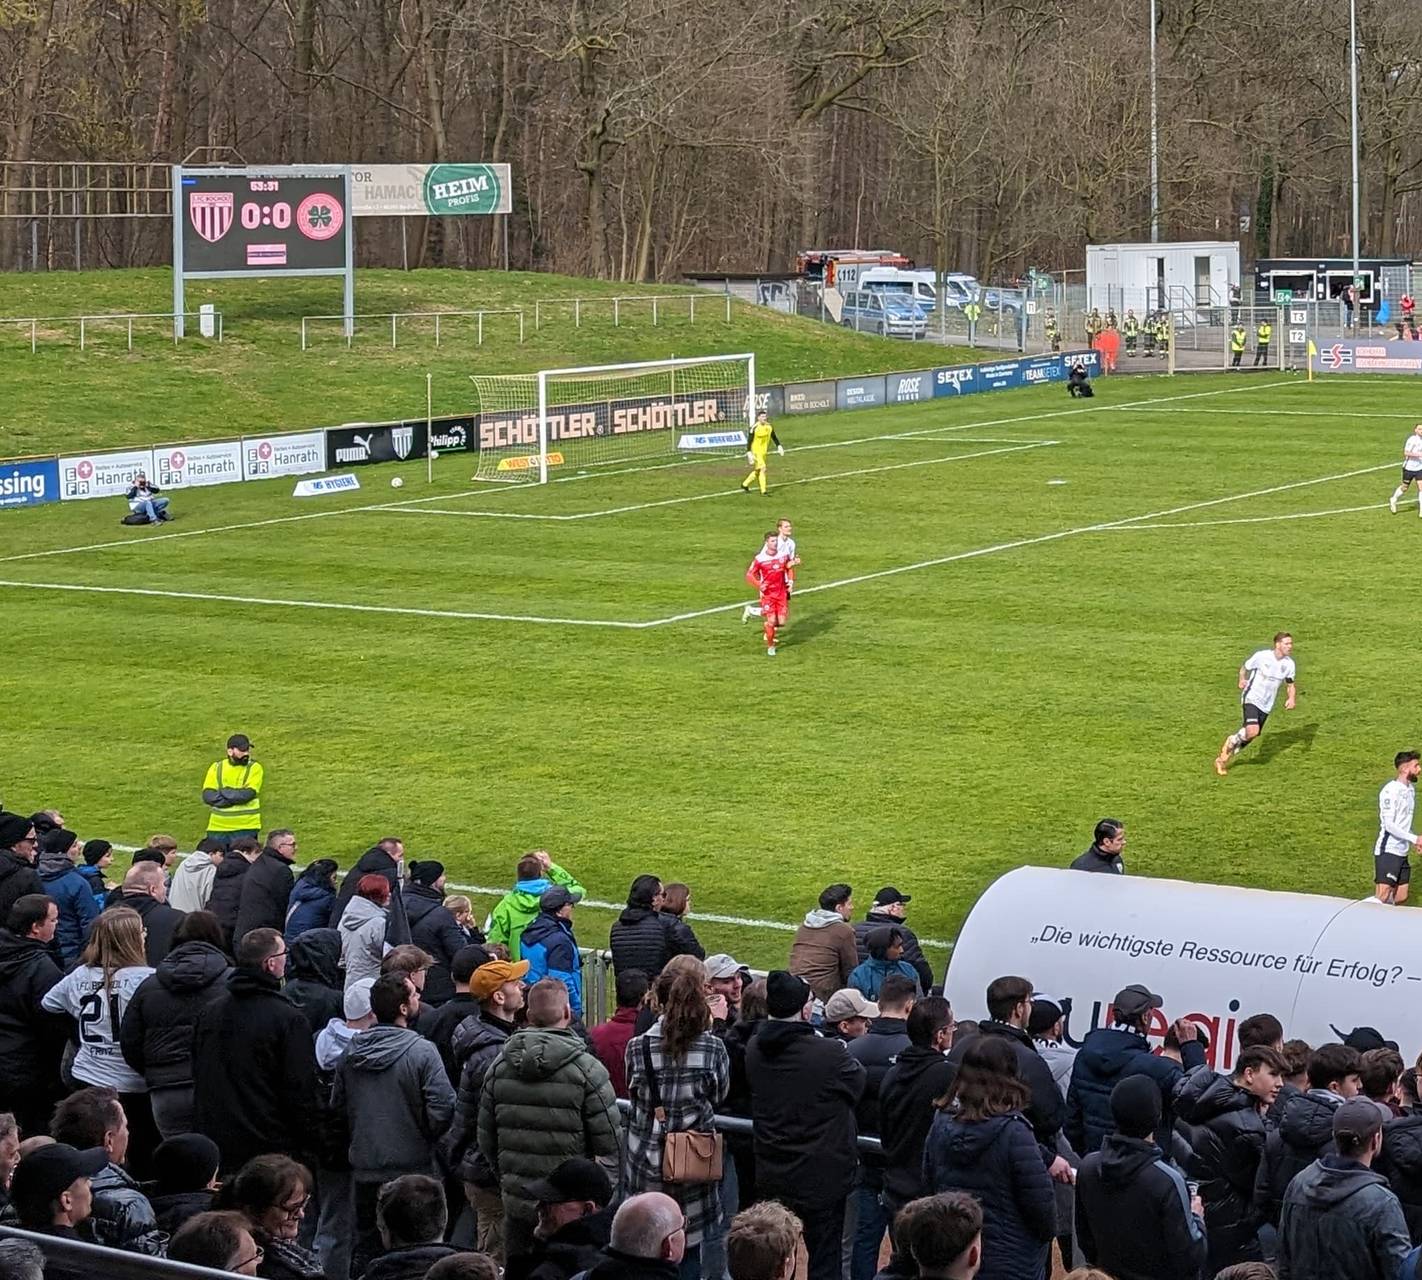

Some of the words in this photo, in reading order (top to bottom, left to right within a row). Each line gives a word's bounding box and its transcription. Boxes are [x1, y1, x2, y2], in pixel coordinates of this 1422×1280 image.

[364, 184, 420, 201] HAMAC
[432, 174, 489, 200] HEIM
[447, 193, 480, 208] PROFIS
[241, 202, 292, 230] 0:0
[1293, 312, 1305, 321] T3
[1292, 331, 1304, 340] T2
[898, 377, 922, 394] ROSE
[937, 368, 974, 386] SETEX
[613, 398, 718, 433] SCHÖTTLER
[274, 449, 319, 466] Hanrath
[187, 459, 235, 476] Hanrath
[1031, 924, 1073, 945] „Die
[1078, 930, 1174, 958] wichtigste
[1179, 941, 1288, 971] Ressource
[1293, 954, 1323, 975] für
[1326, 958, 1403, 988] Erfolg?
[80, 992, 121, 1043] 21
